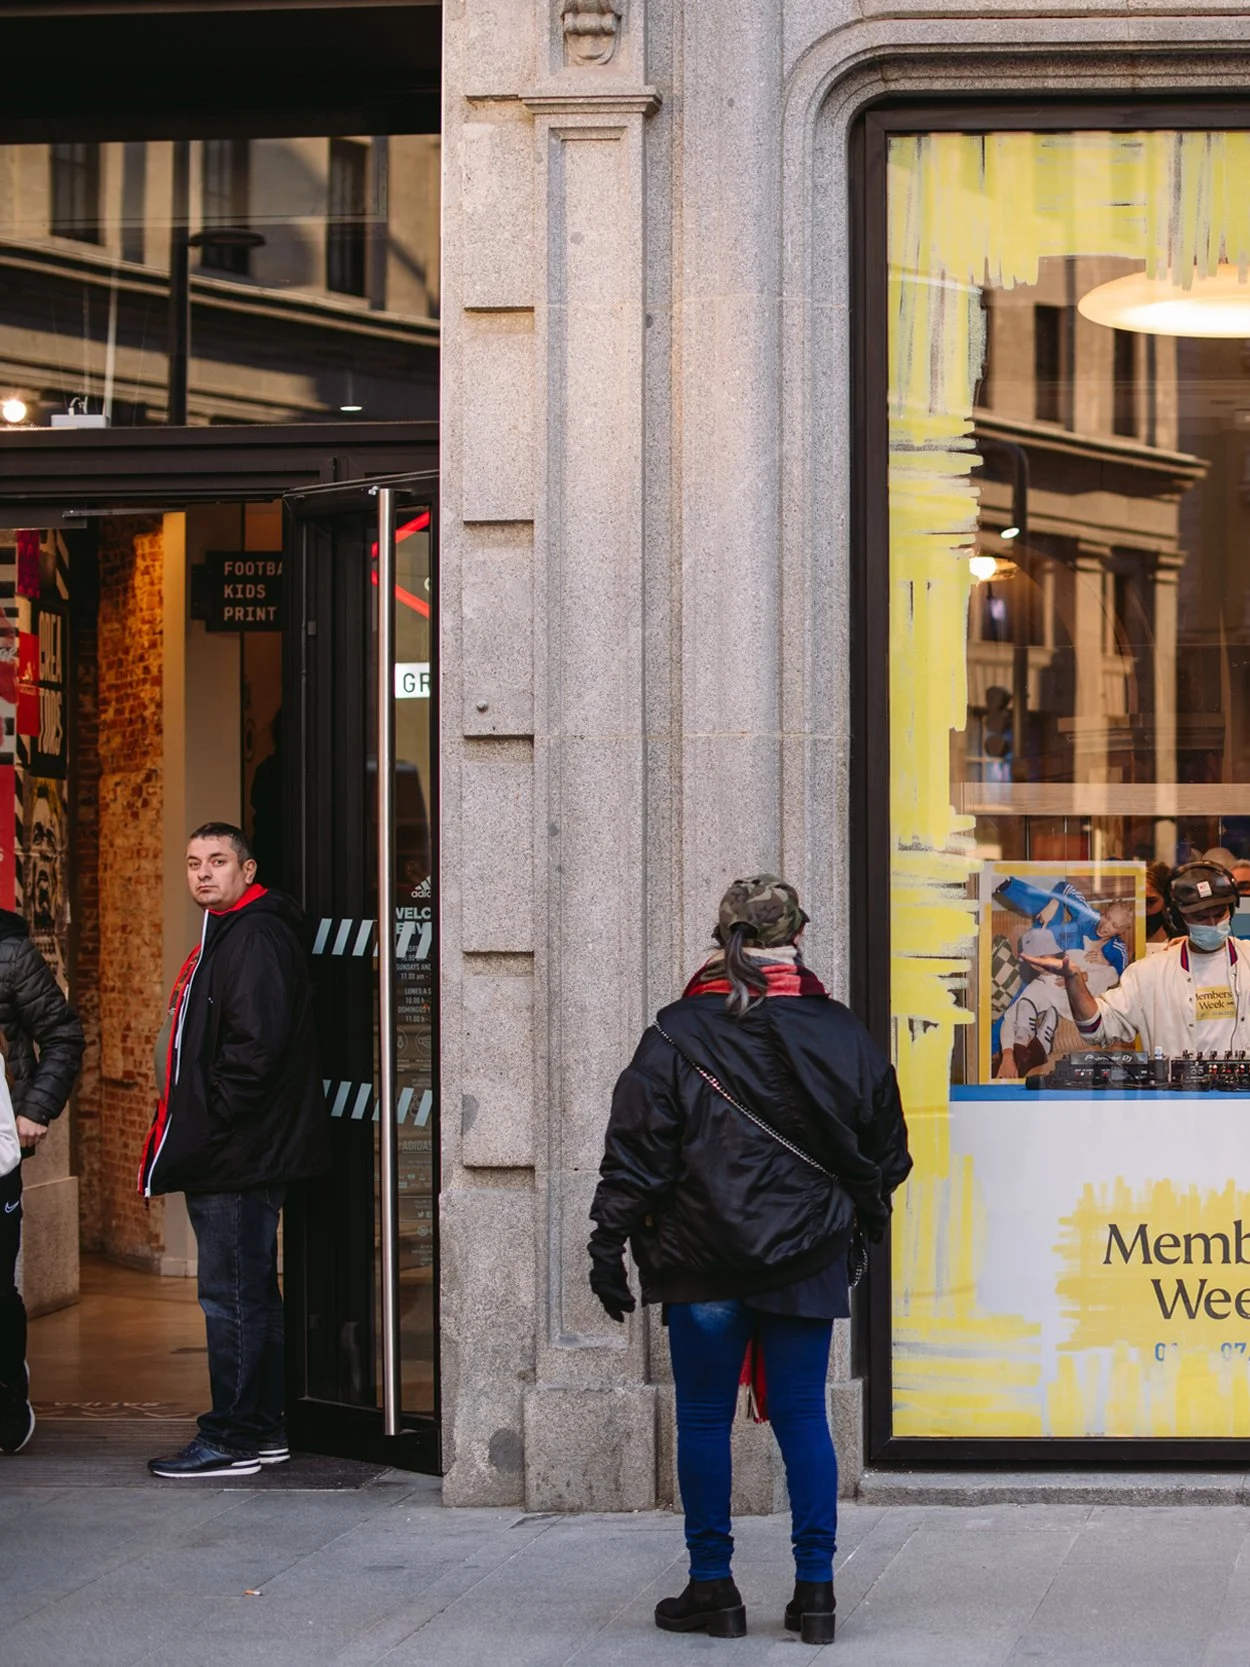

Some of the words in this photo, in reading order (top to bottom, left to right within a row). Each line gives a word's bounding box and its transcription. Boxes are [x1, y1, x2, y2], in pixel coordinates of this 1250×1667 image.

[224, 584, 266, 599] KIDS
[224, 606, 277, 622] PRINT
[403, 672, 430, 693] GR
[1198, 1000, 1225, 1010] Week
